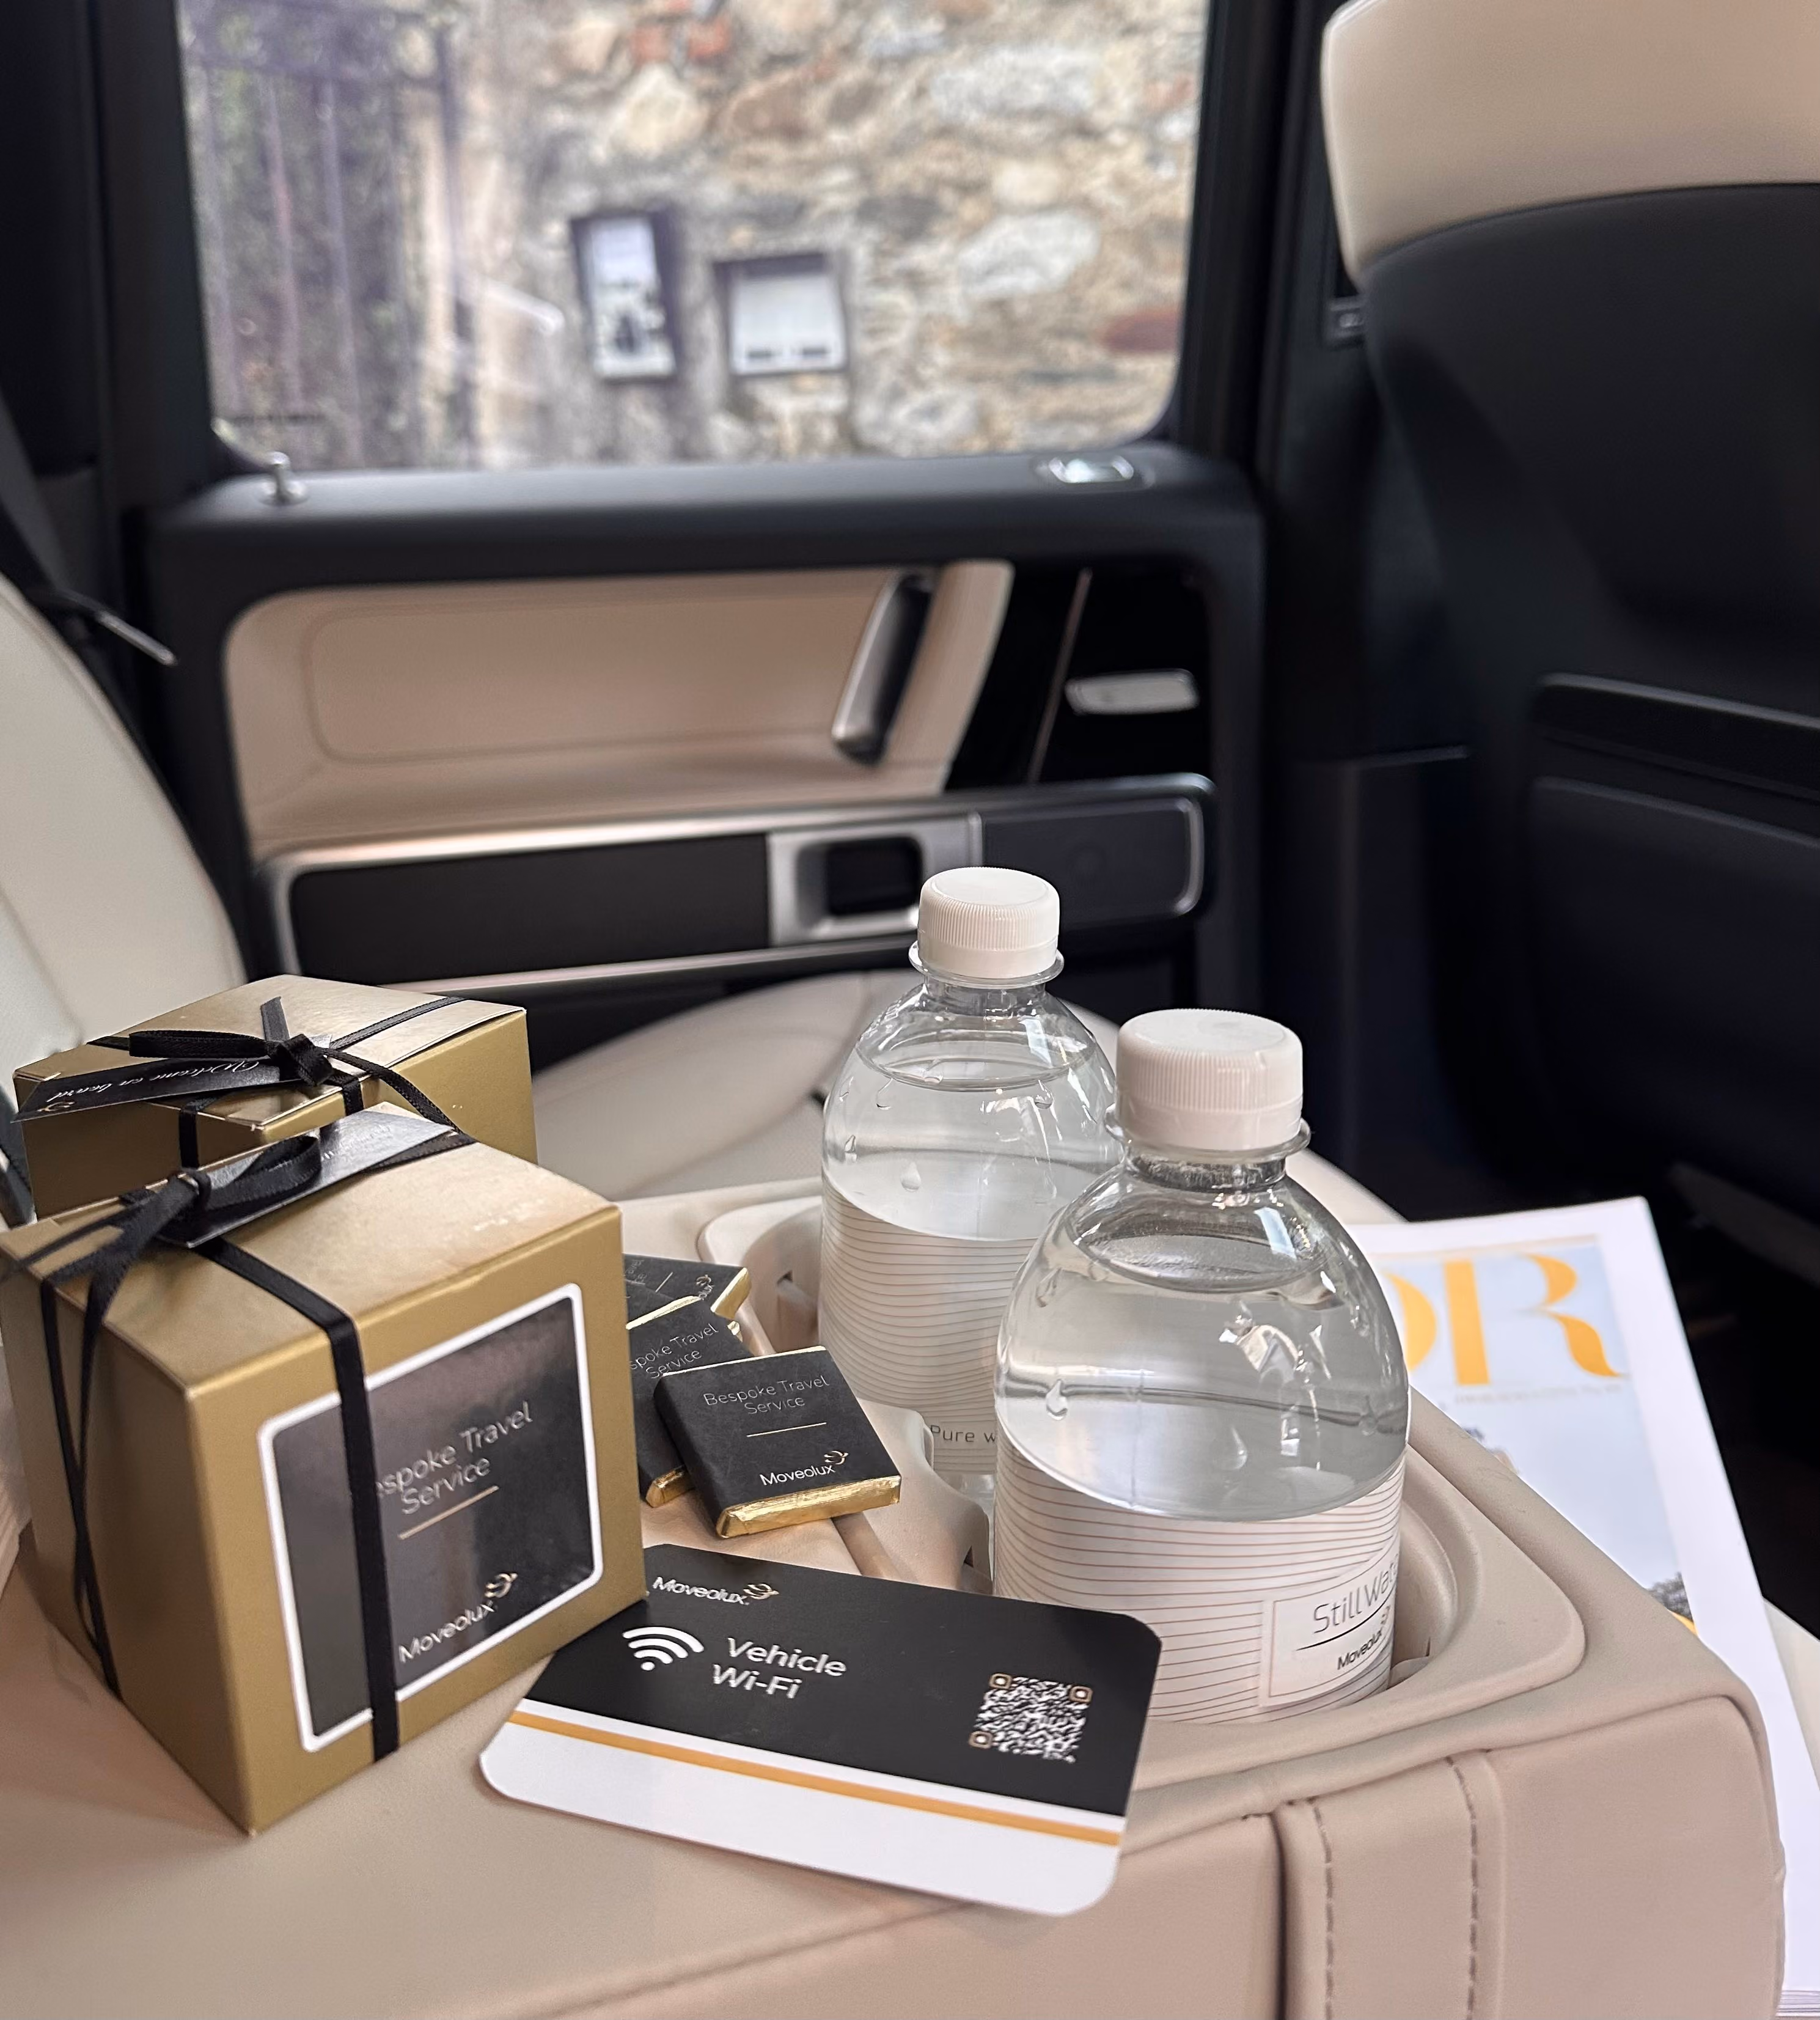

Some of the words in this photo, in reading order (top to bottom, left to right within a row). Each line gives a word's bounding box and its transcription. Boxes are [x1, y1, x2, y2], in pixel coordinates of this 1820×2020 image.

[630, 1339, 672, 1370] spoke
[670, 1323, 719, 1348] Travel
[645, 1350, 702, 1379] Service
[703, 1384, 776, 1406] Bespoke
[780, 1375, 830, 1394] Travel
[744, 1395, 805, 1415] Service
[375, 1445, 457, 1498] spoke
[459, 1400, 533, 1453] Travel
[930, 1424, 975, 1442] Pure
[401, 1458, 490, 1515] Service
[760, 1464, 836, 1486] Moveolux
[398, 1601, 496, 1662] Moveolux
[727, 1637, 847, 1677] Vehicle
[713, 1664, 802, 1699] Wi-Fi
